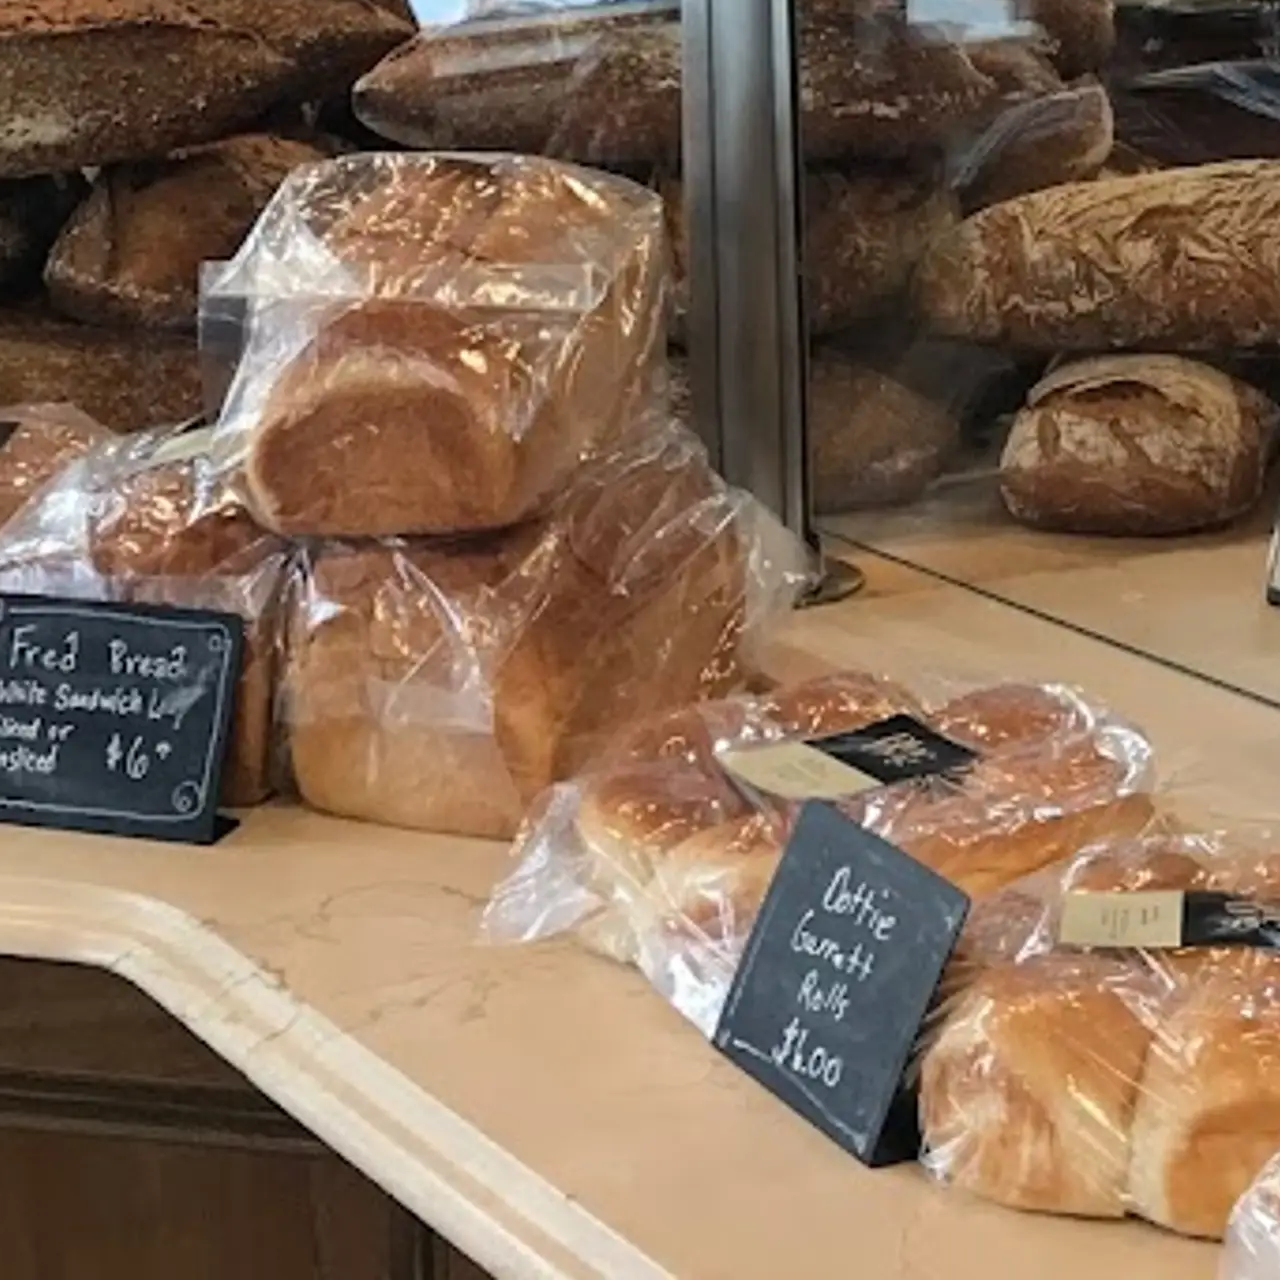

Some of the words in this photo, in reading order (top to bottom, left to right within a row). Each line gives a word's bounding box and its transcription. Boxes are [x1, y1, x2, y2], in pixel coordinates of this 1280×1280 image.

[9, 624, 80, 673] Fred
[47, 724, 76, 741] or
[796, 968, 851, 1022] Rolls
